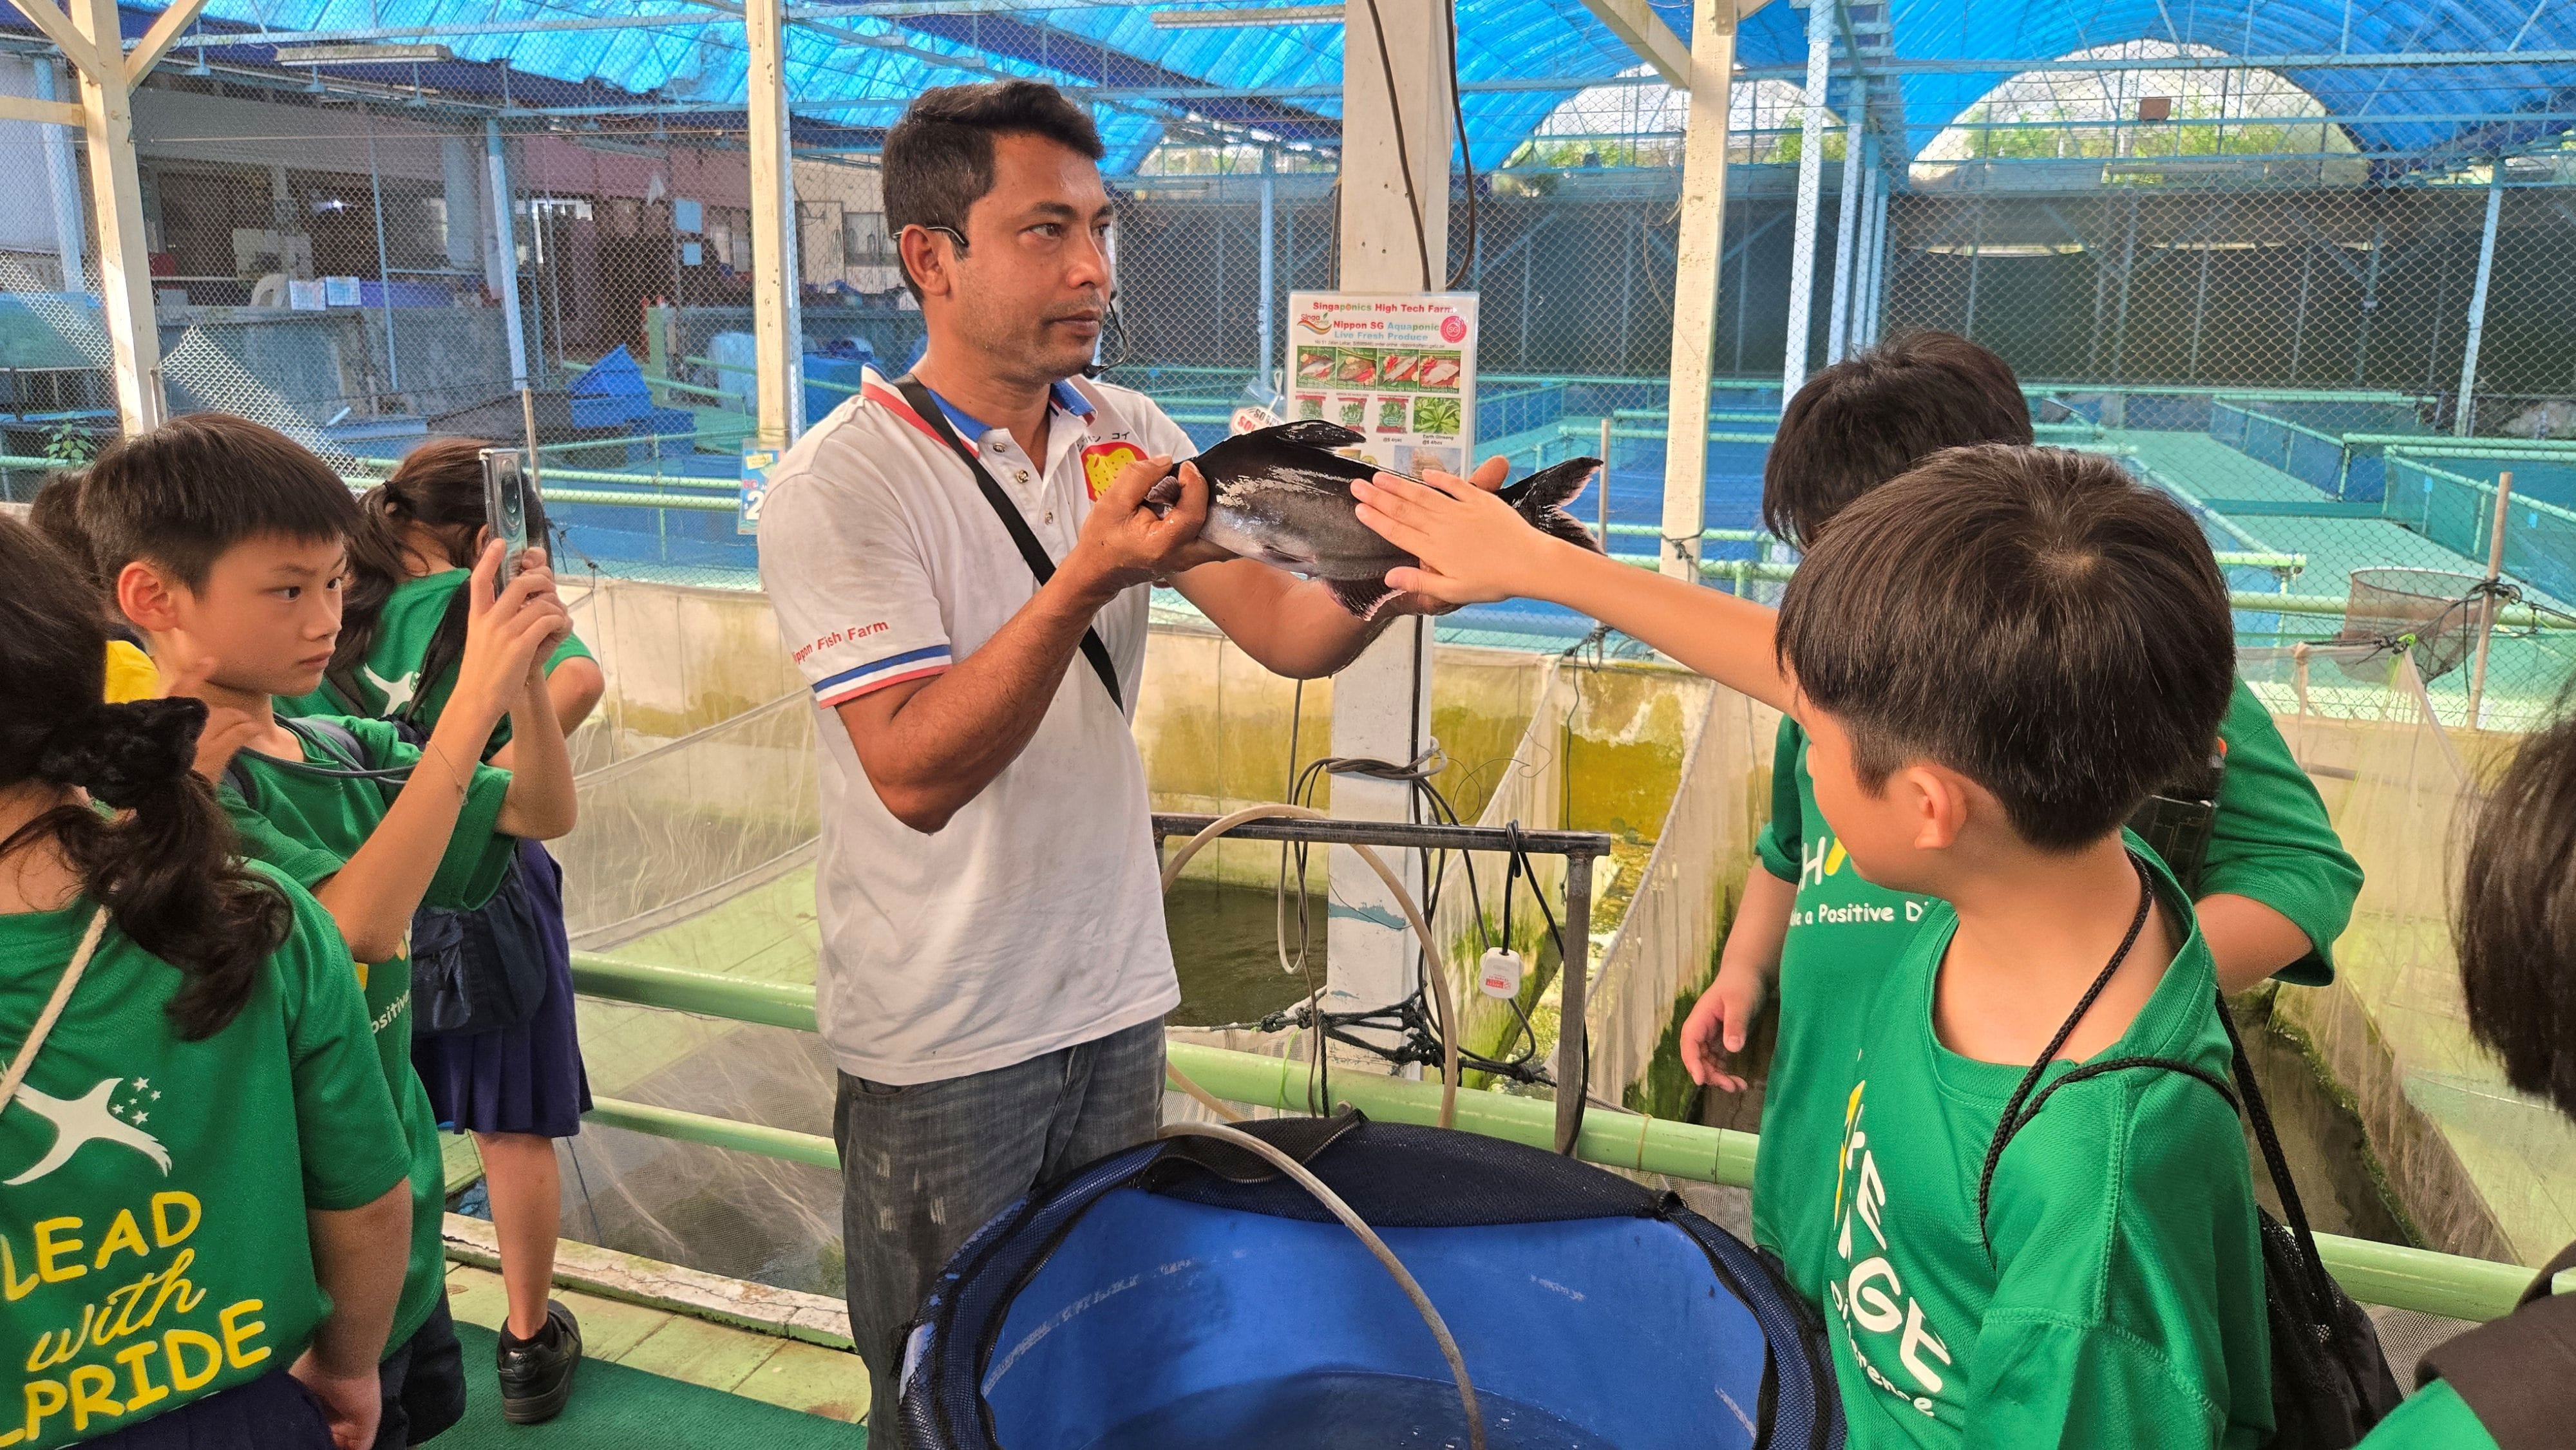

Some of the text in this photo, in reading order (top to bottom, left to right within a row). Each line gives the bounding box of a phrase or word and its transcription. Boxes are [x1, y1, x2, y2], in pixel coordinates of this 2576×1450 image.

[1301, 314, 1320, 322] Singa
[1313, 302, 1454, 314] Singaponics High Tech Farm
[1333, 321, 1367, 332] Nippon
[1370, 321, 1384, 330] SG
[1334, 331, 1428, 341] Live Fresh Produce
[817, 632, 842, 650] Fish
[847, 621, 889, 641] Farm
[1804, 910, 1814, 925] a
[1818, 902, 1895, 923] Positive
[0, 1191, 202, 1301] LEAD
[27, 1248, 207, 1372] with
[24, 1298, 272, 1441] PRIDE
